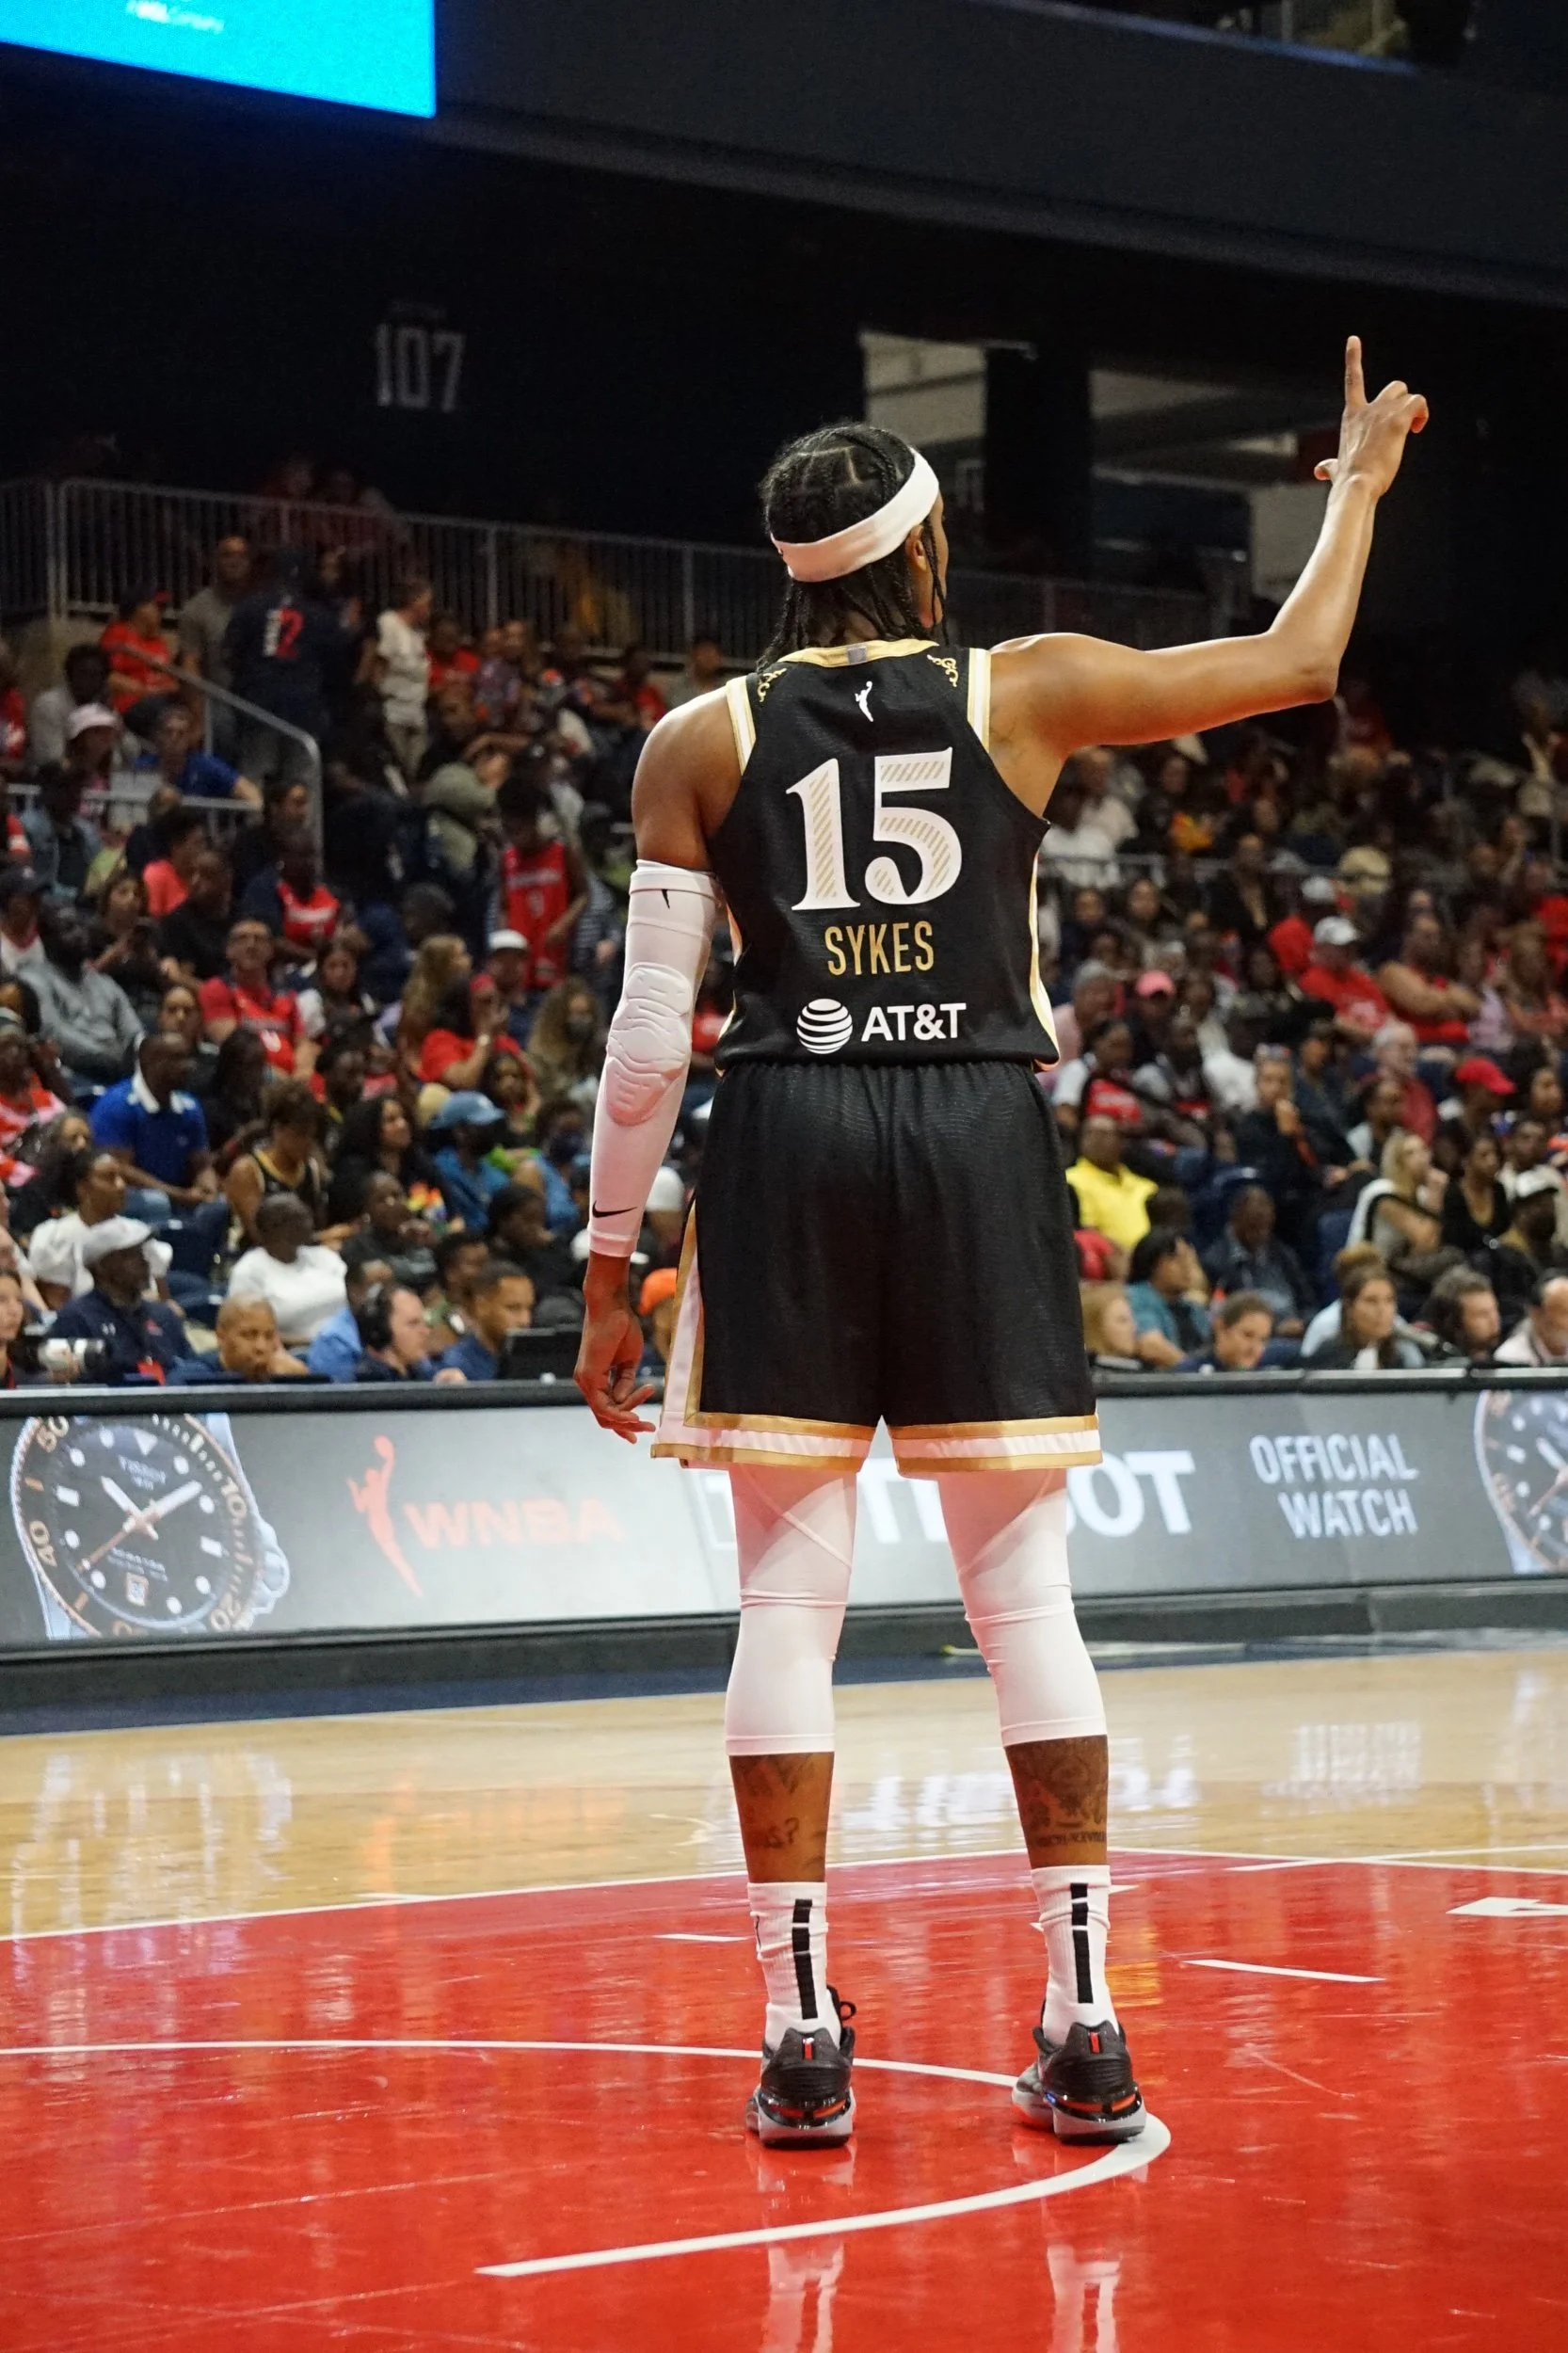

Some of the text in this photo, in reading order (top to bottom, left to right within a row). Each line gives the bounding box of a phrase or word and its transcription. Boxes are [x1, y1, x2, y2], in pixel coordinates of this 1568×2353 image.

[375, 323, 466, 413] 107
[786, 746, 962, 911] 15
[824, 920, 935, 976] SYKES
[860, 1002, 967, 1042] AT&T
[1249, 1433, 1419, 1484] OFFICIAL
[403, 1497, 627, 1549] WNBA
[856, 1450, 1196, 1544] TIOT
[1277, 1489, 1418, 1539] WATCH
